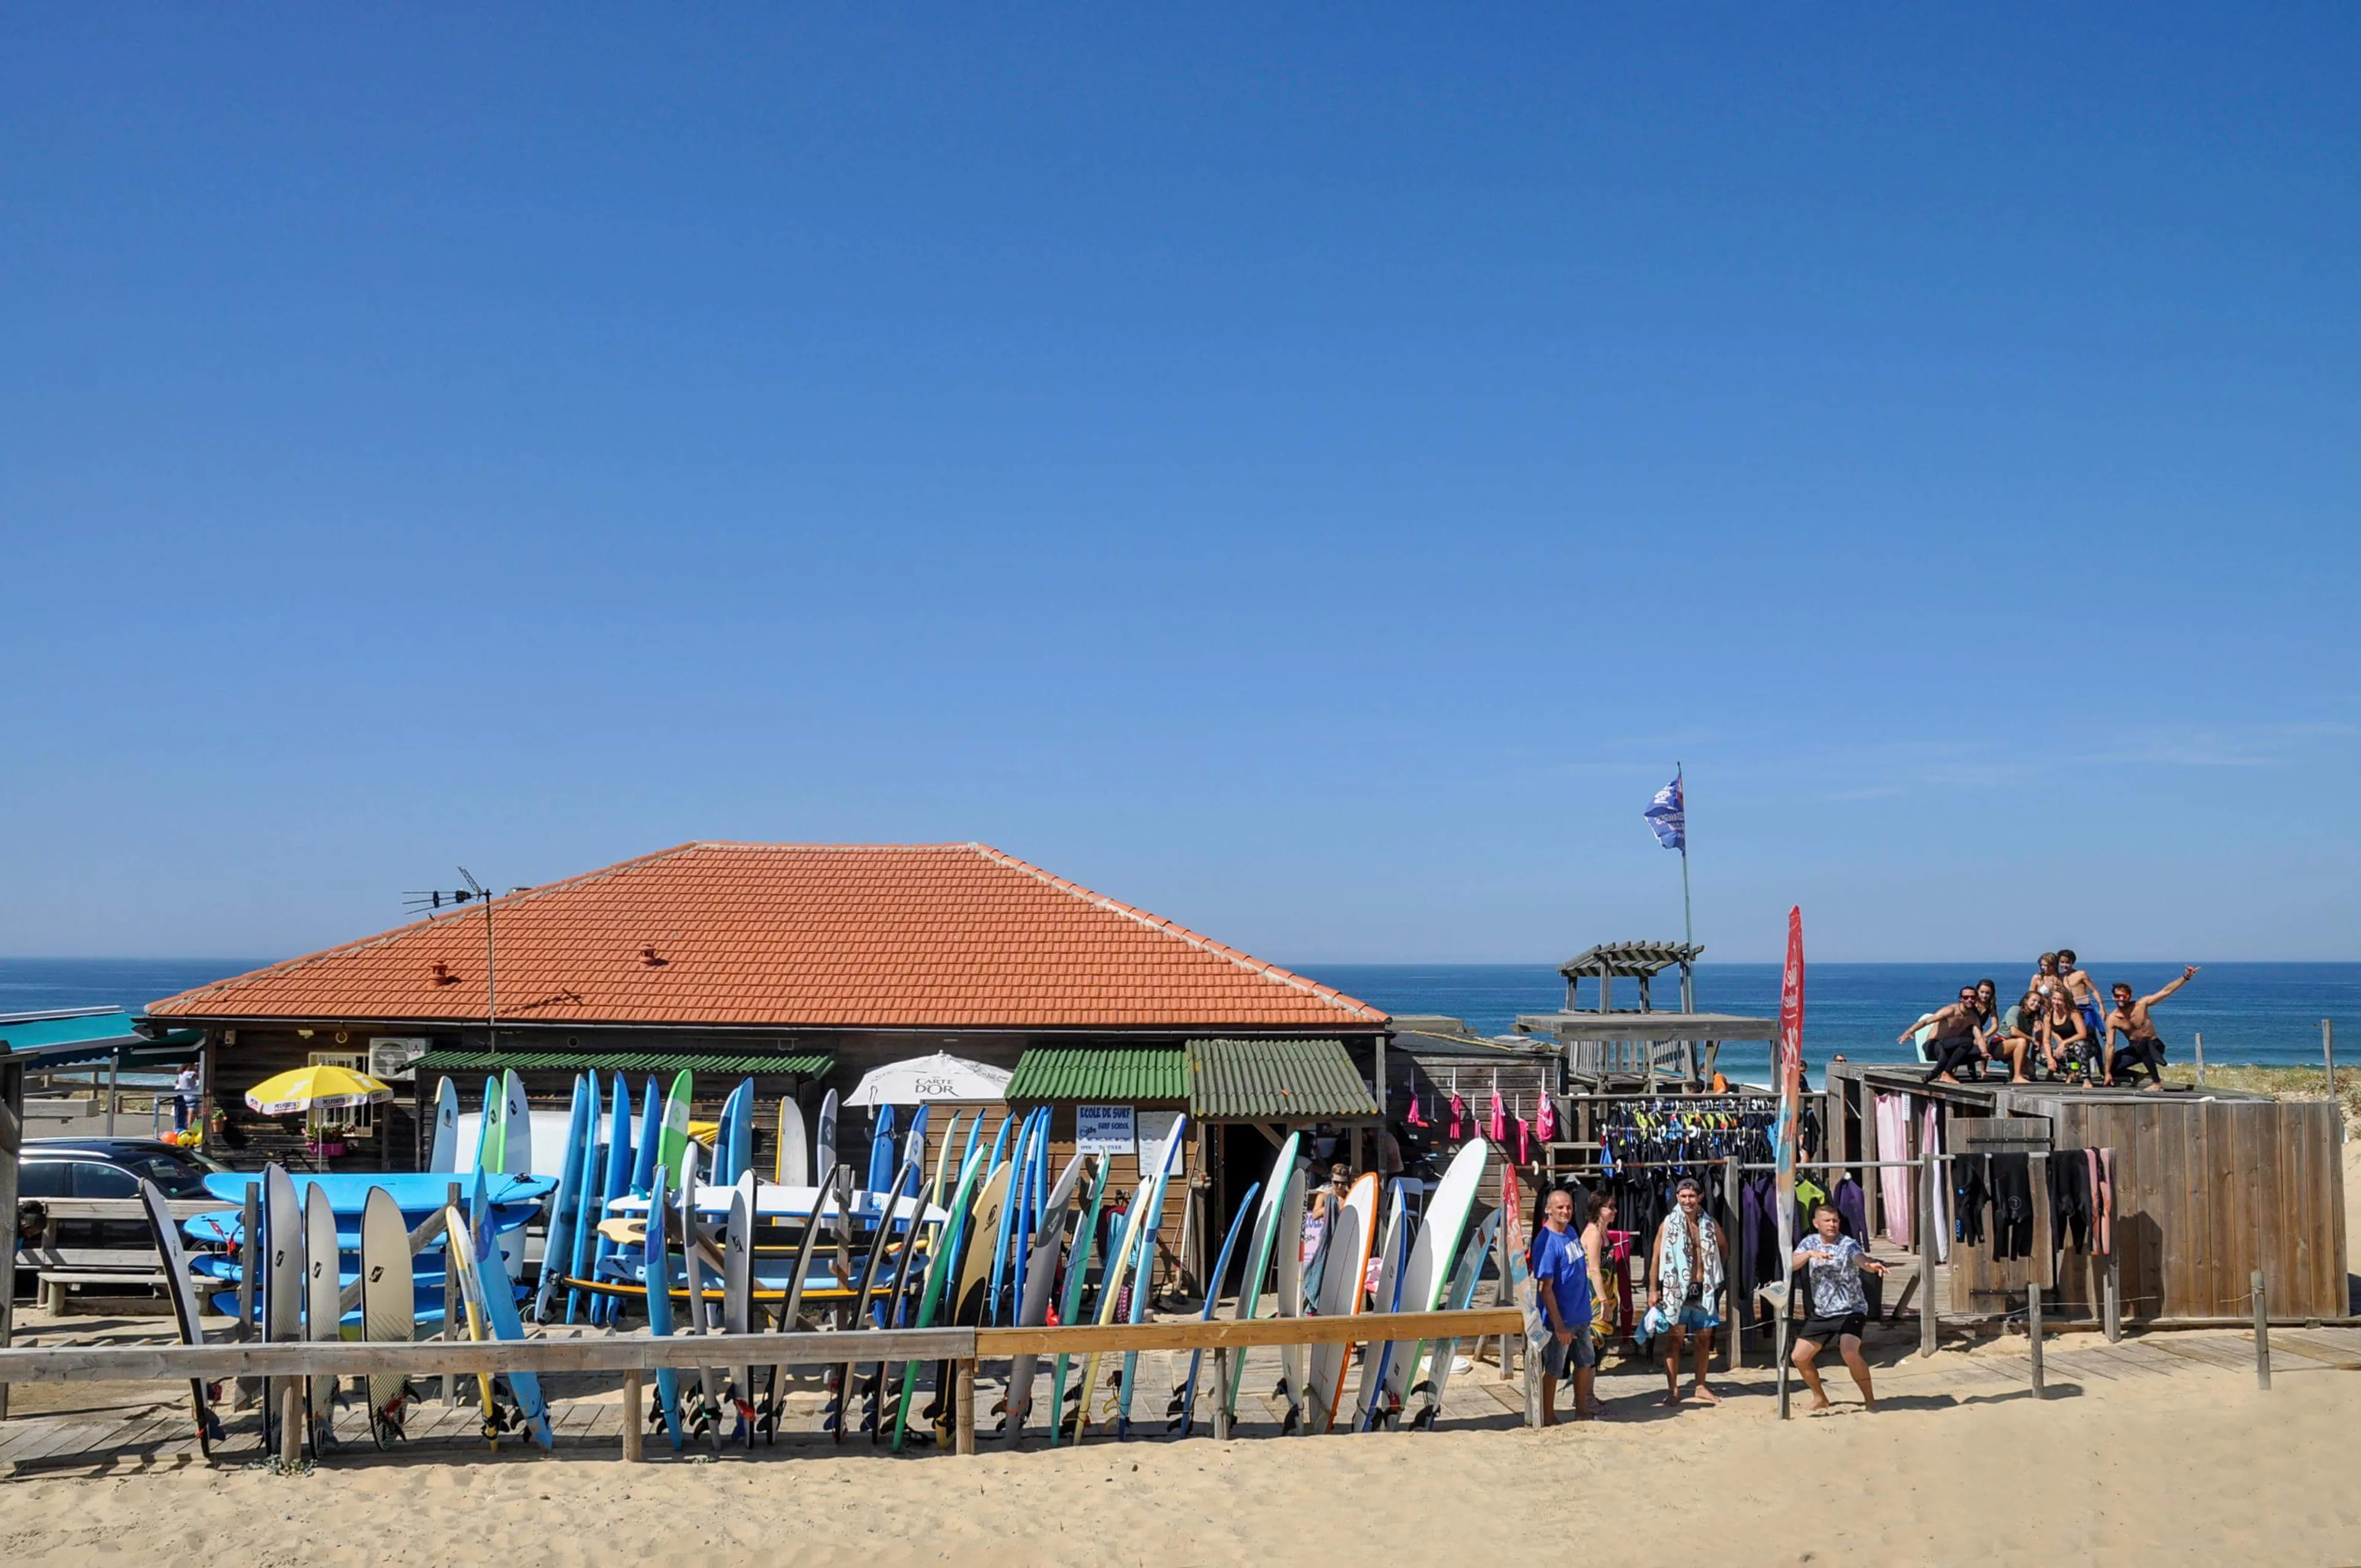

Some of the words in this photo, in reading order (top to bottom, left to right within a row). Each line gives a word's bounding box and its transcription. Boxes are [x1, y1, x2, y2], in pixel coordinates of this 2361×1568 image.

[1080, 1107, 1101, 1118] ECOLE
[1102, 1107, 1112, 1118] DE
[1113, 1107, 1131, 1118] SURF
